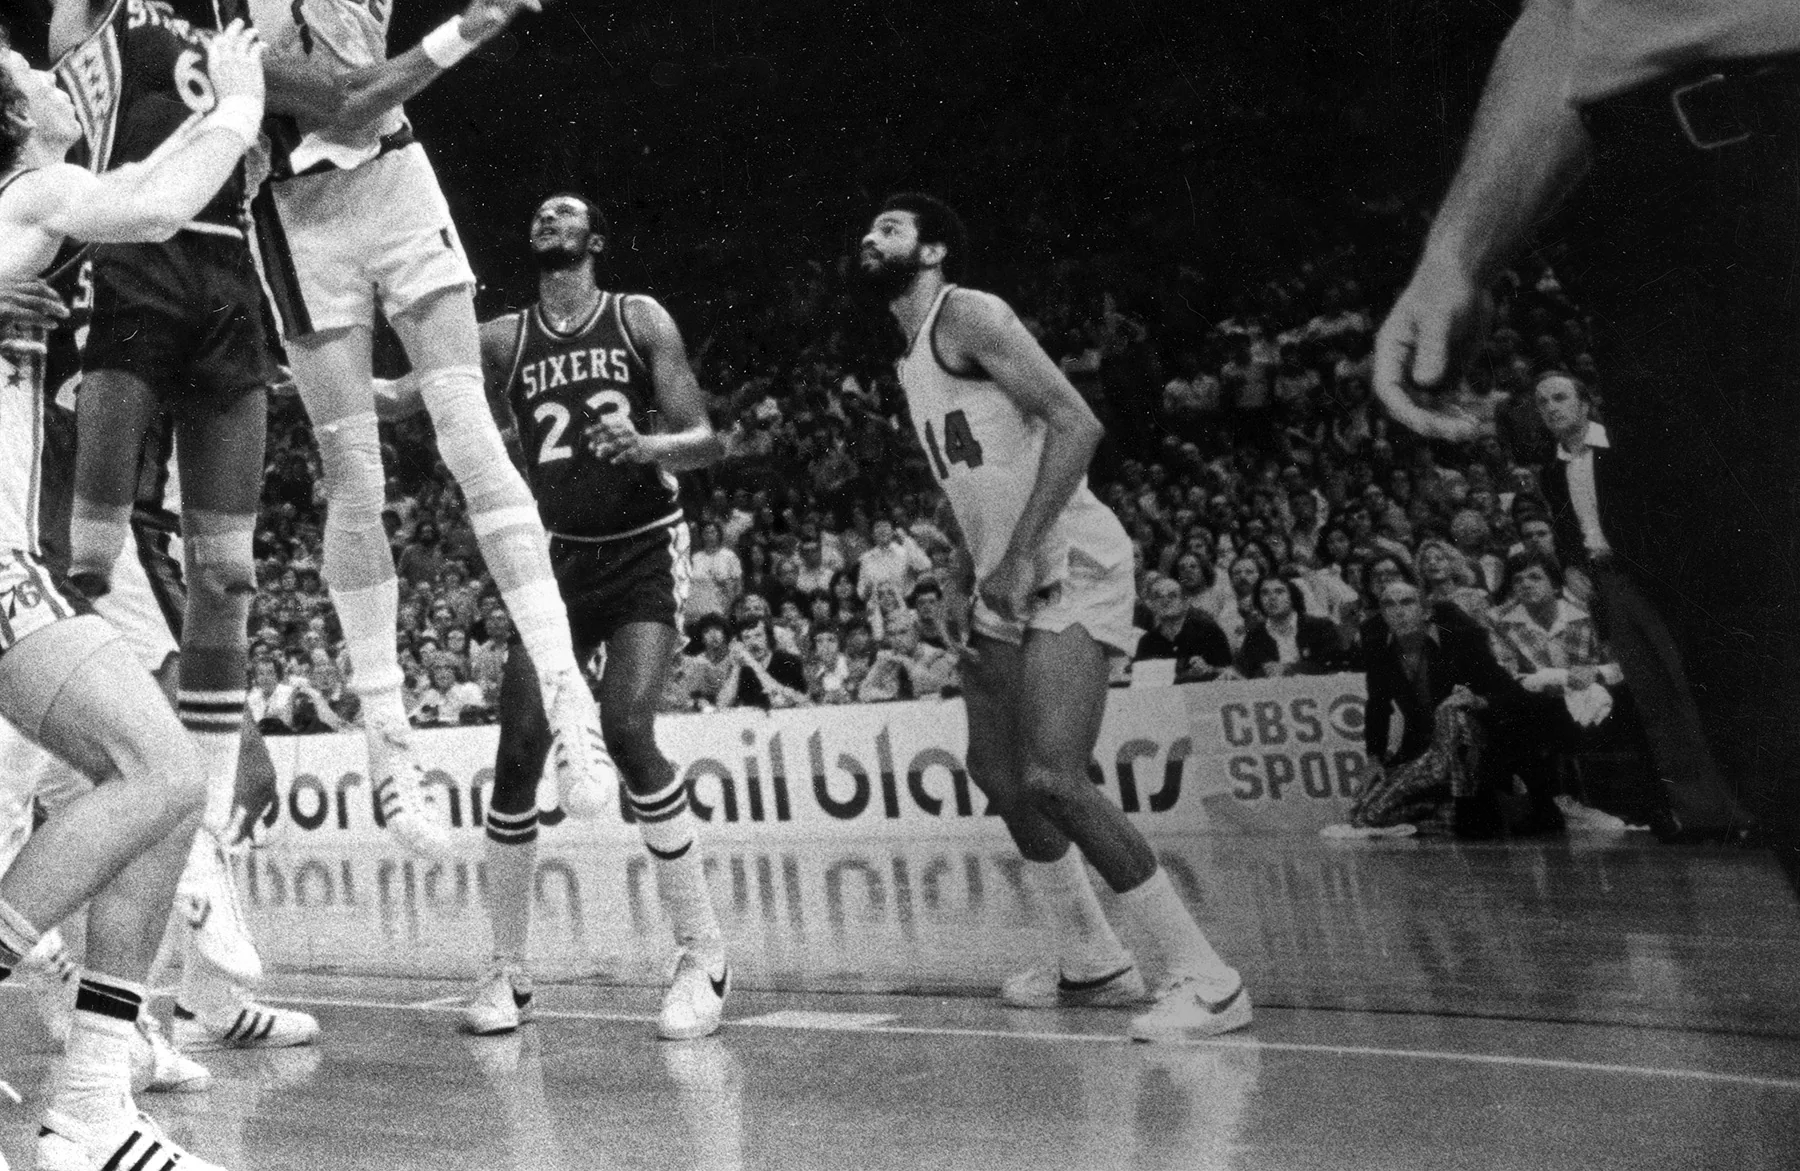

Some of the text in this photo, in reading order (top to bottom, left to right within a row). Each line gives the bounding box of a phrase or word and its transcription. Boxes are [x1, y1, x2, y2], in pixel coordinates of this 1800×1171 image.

[174, 49, 216, 114] 6
[521, 348, 630, 400] SIXERS
[925, 408, 984, 481] 14
[1220, 697, 1324, 748] CBS
